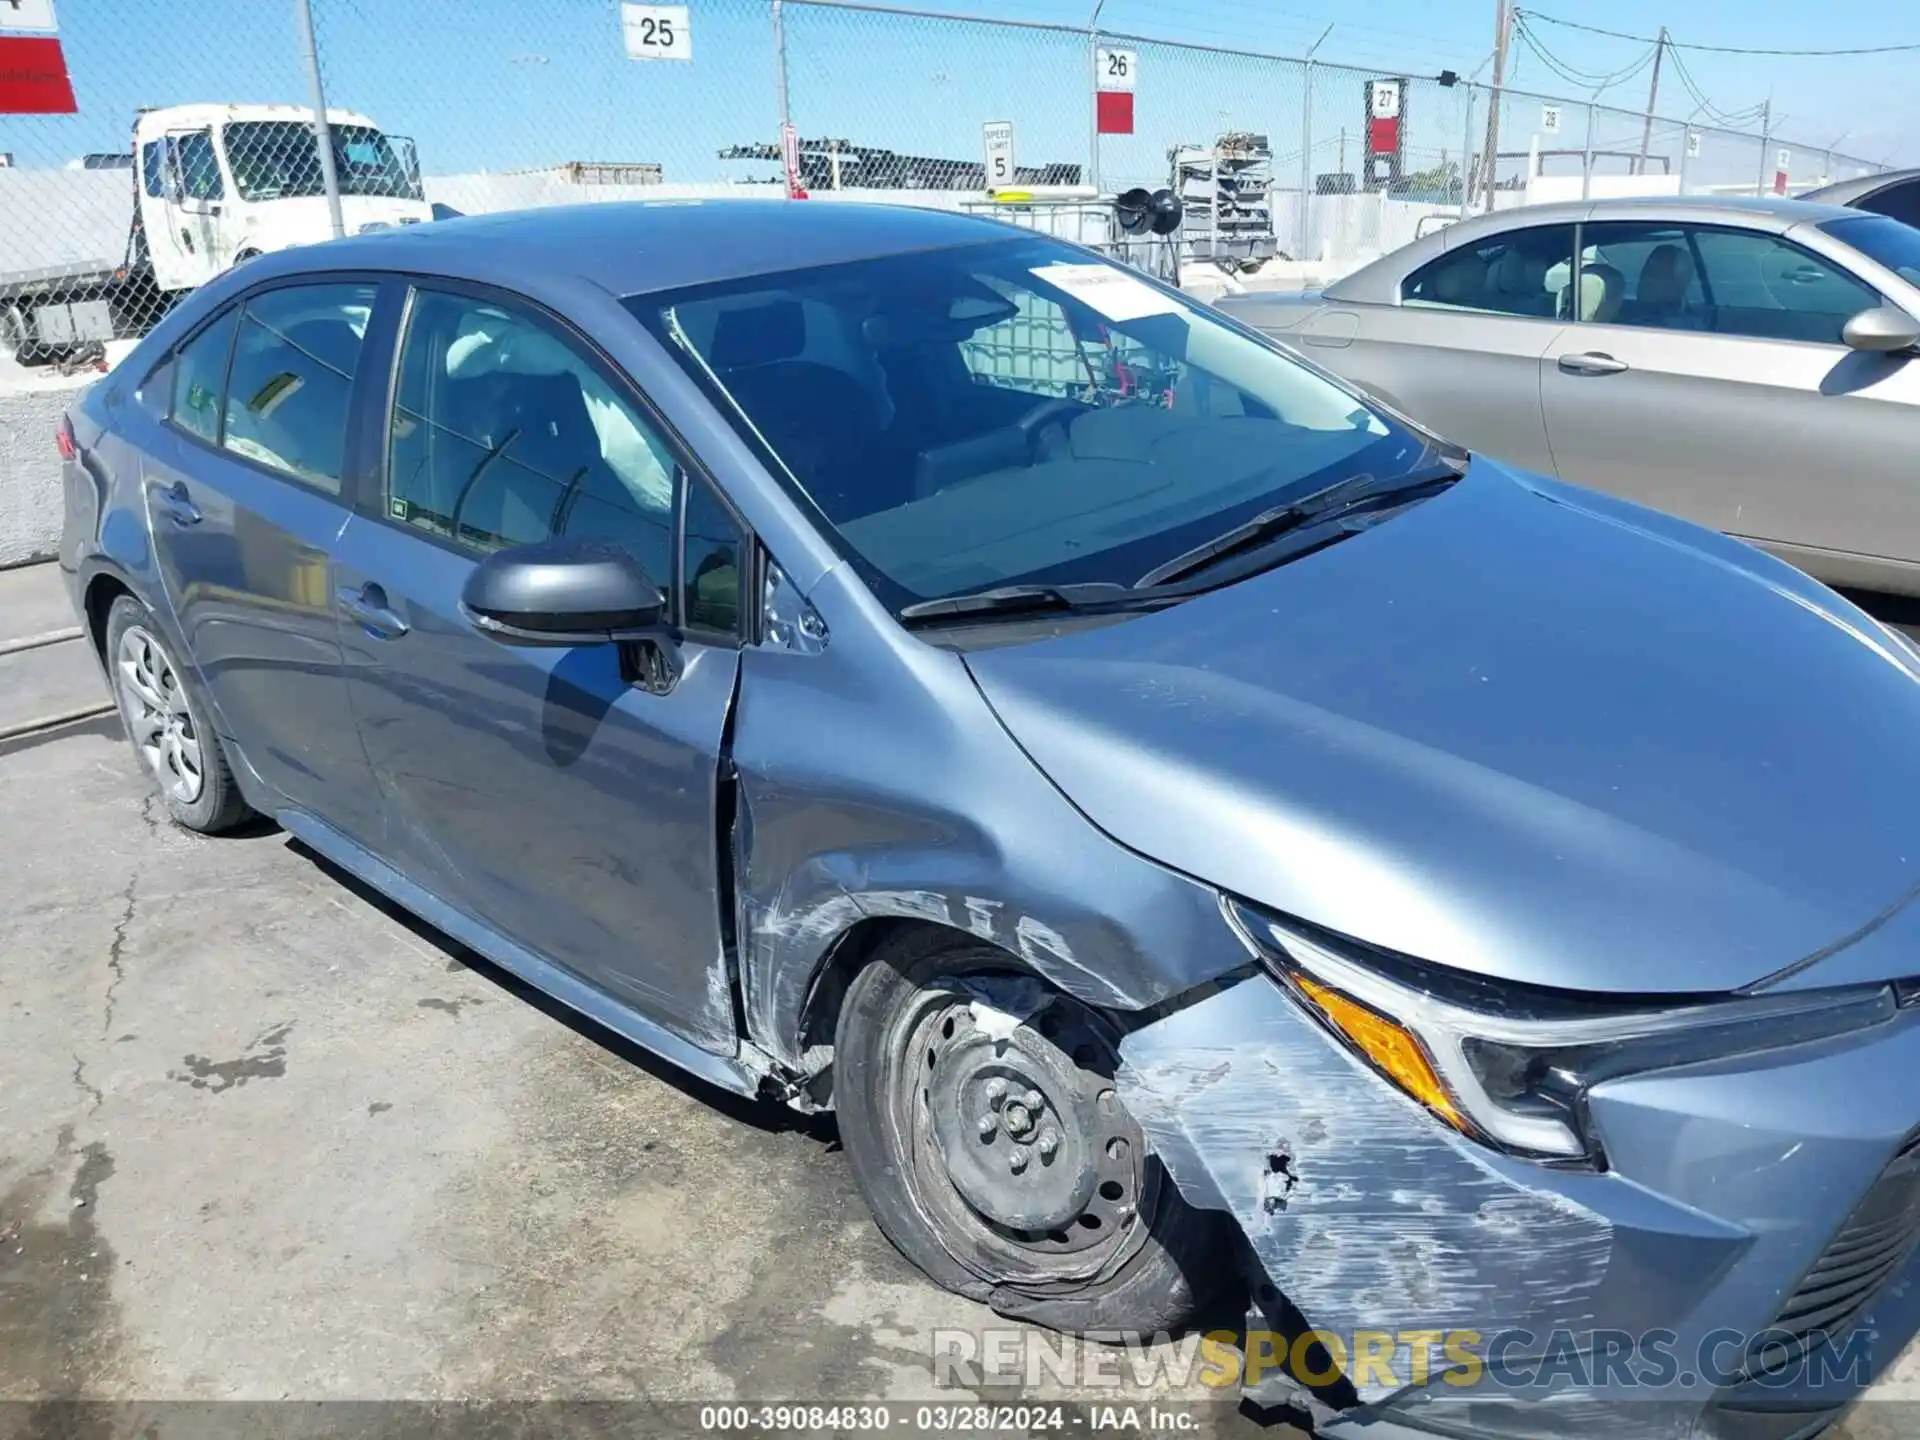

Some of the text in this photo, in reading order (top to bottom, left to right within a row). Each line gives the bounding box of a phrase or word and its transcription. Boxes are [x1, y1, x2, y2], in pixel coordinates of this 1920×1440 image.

[641, 17, 674, 47] 25
[1108, 53, 1127, 77] 26
[1378, 89, 1393, 108] 27
[984, 128, 1010, 140] SPEED
[989, 141, 1008, 151] LIMIT
[994, 157, 1006, 178] 5
